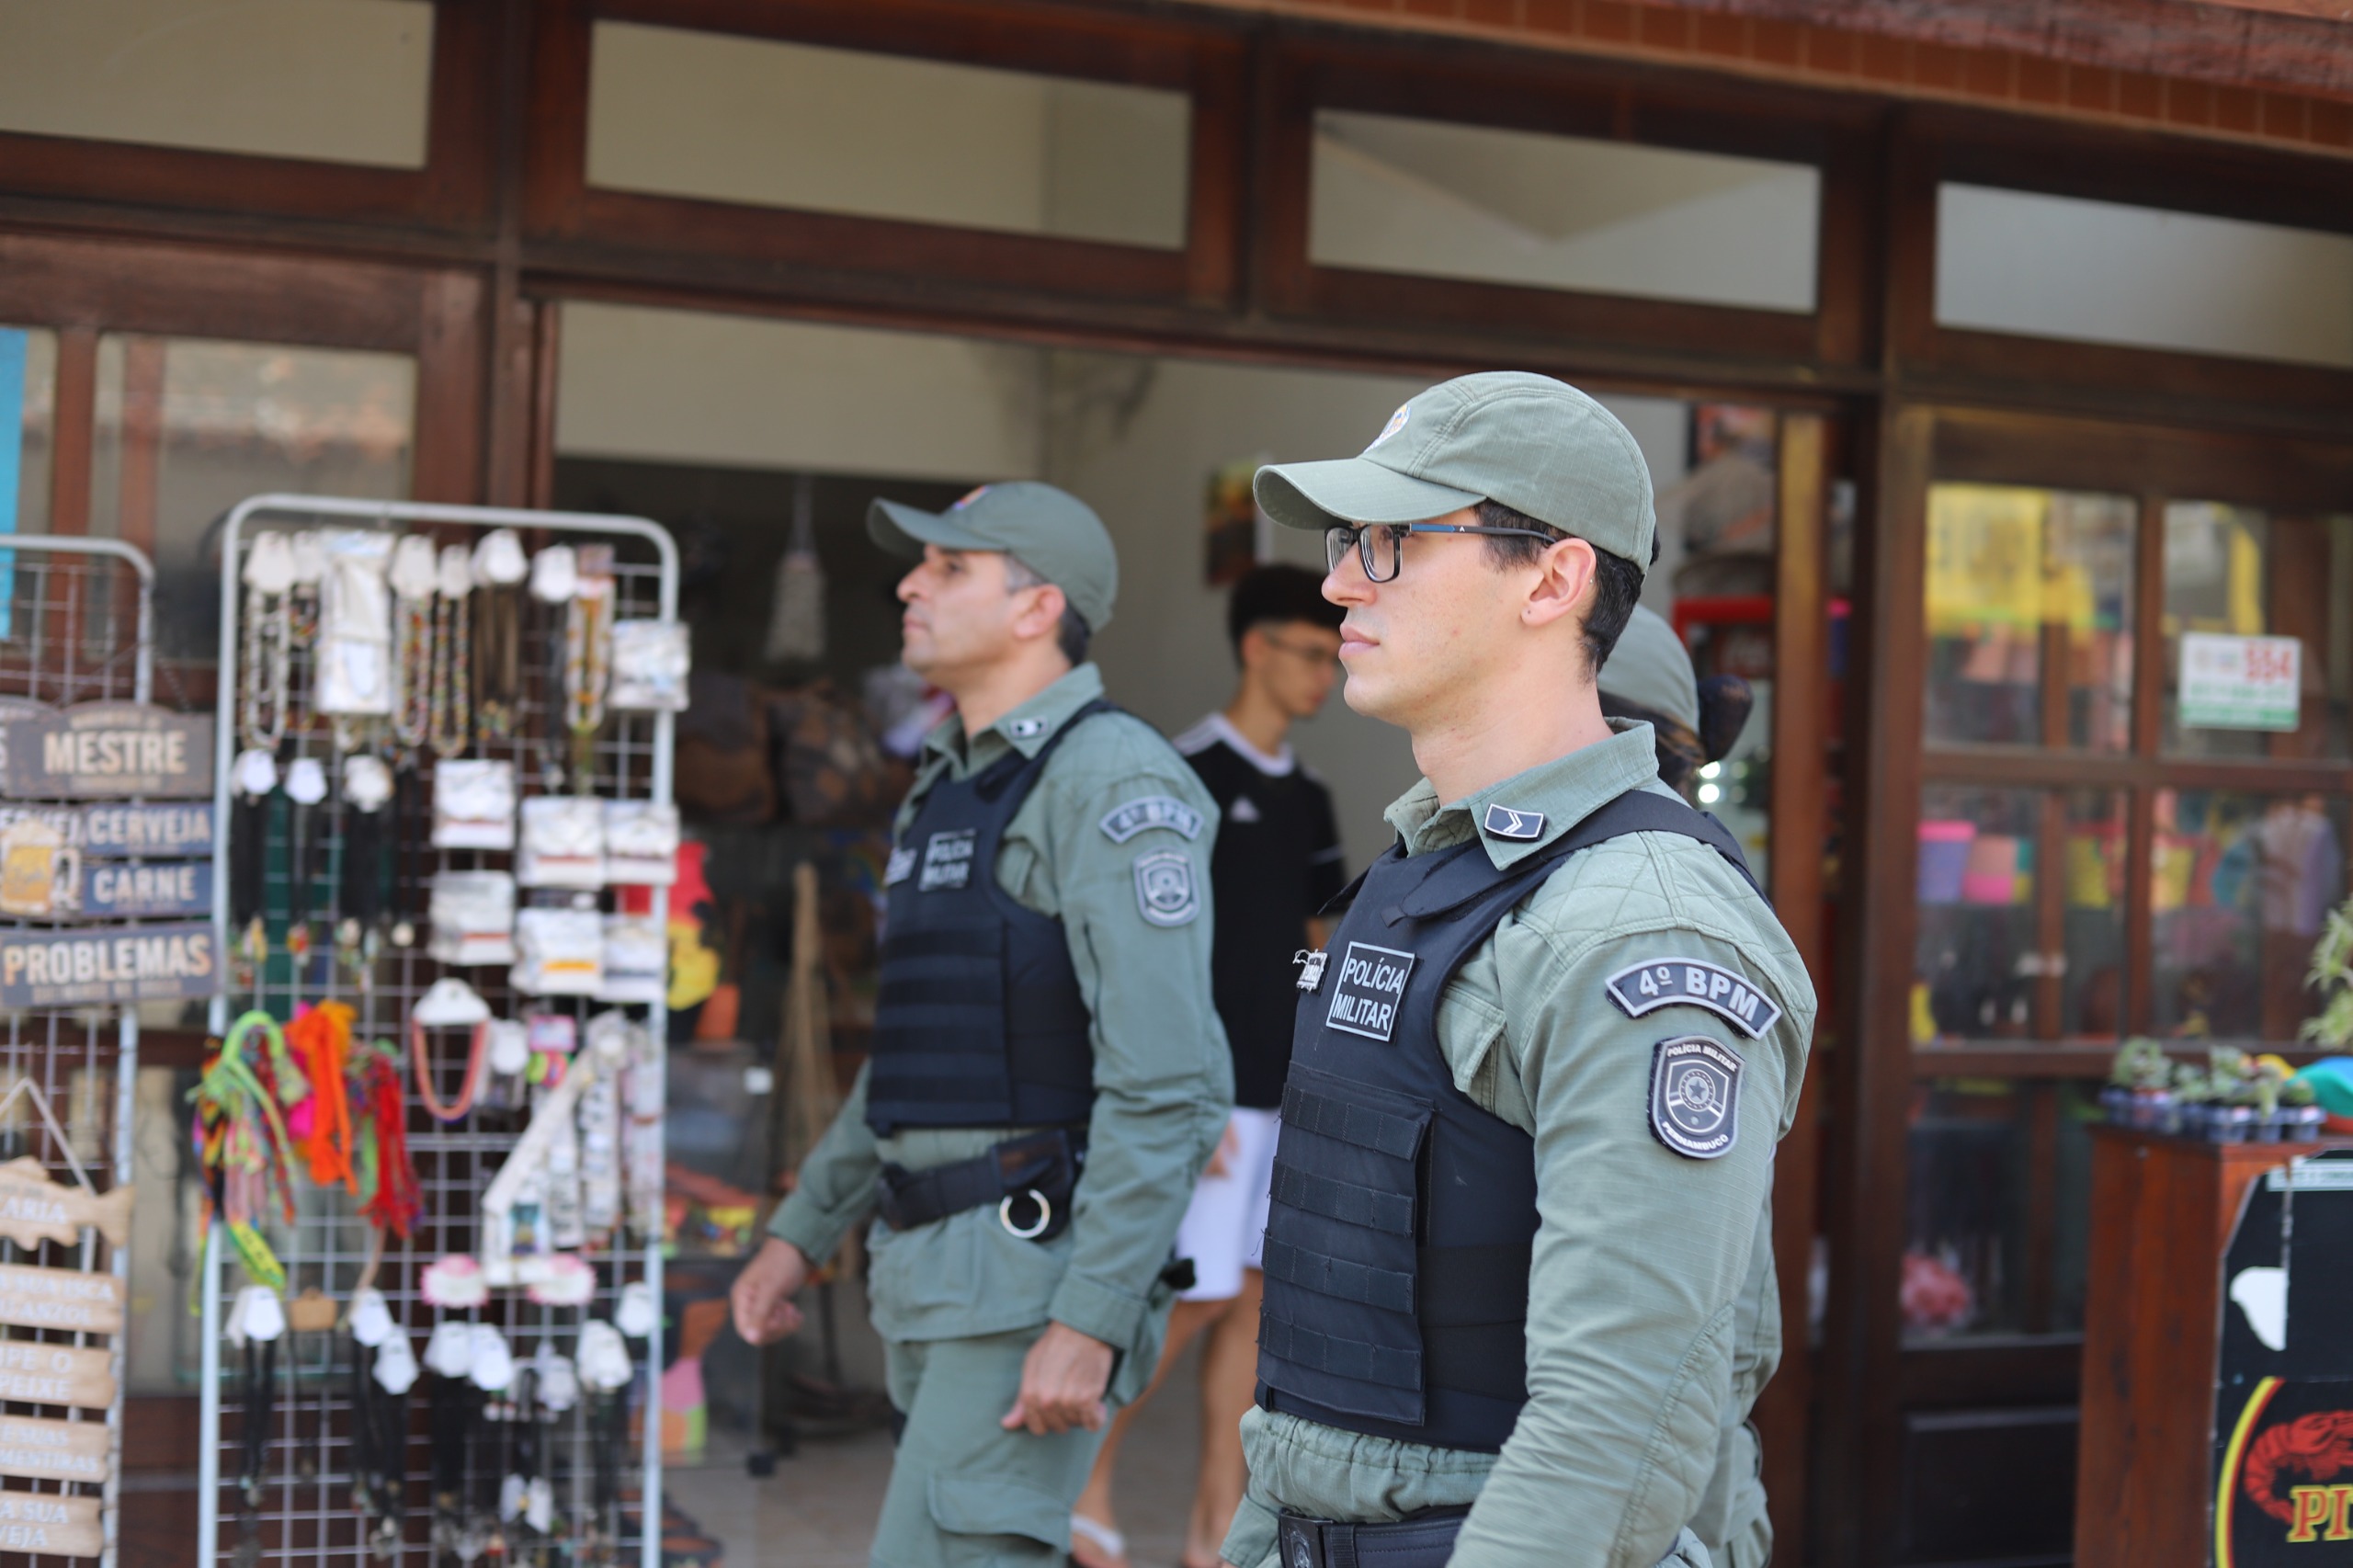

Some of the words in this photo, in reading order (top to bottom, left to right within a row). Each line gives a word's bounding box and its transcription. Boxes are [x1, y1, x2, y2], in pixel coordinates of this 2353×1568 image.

[44, 730, 188, 774] MESTRE
[88, 808, 212, 845] CERVEJA
[94, 866, 197, 903] CARNE
[4, 934, 212, 986] PROBLEMAS
[1343, 957, 1405, 994] POLÍCIA
[1332, 993, 1392, 1031] MILITAR
[1639, 966, 1673, 996] 4º
[1686, 966, 1759, 1022] BPM
[1667, 1043, 1701, 1057] POLÍCIA
[1702, 1045, 1737, 1073] MILITAR
[1662, 1121, 1729, 1151] PERNAMBUCO
[51, 1351, 74, 1374] O
[23, 1501, 68, 1524] SUA
